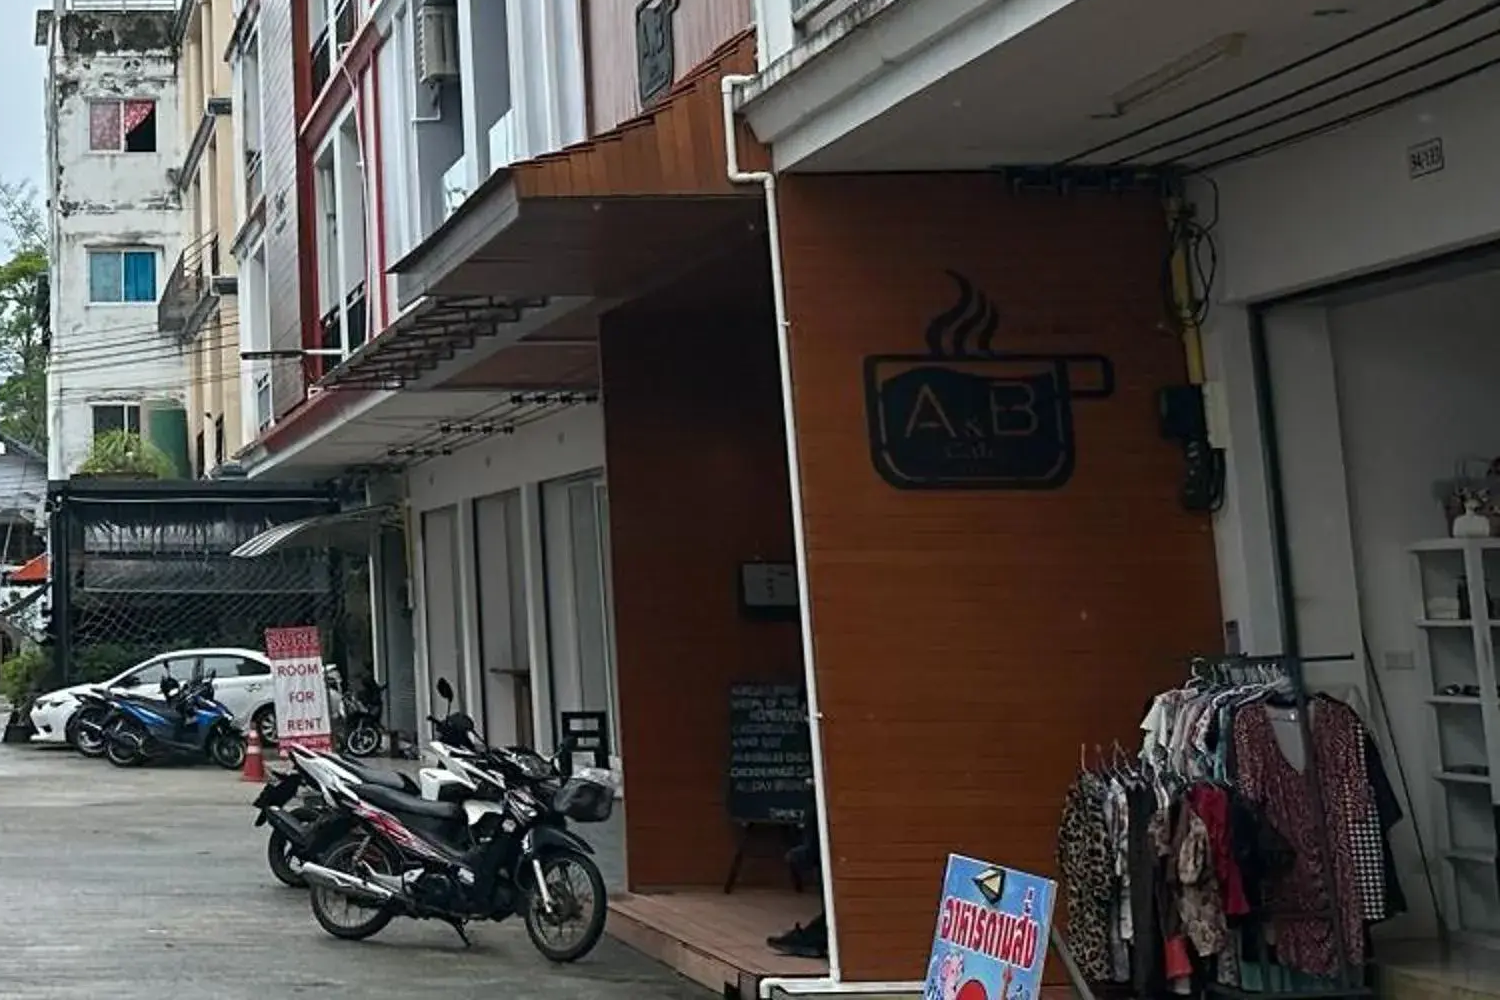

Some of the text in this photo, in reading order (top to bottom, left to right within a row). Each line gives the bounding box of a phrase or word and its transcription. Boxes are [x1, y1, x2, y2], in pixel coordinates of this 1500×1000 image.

[278, 664, 319, 677] ROOM
[289, 691, 315, 703] FOR
[287, 718, 322, 731] RENT
